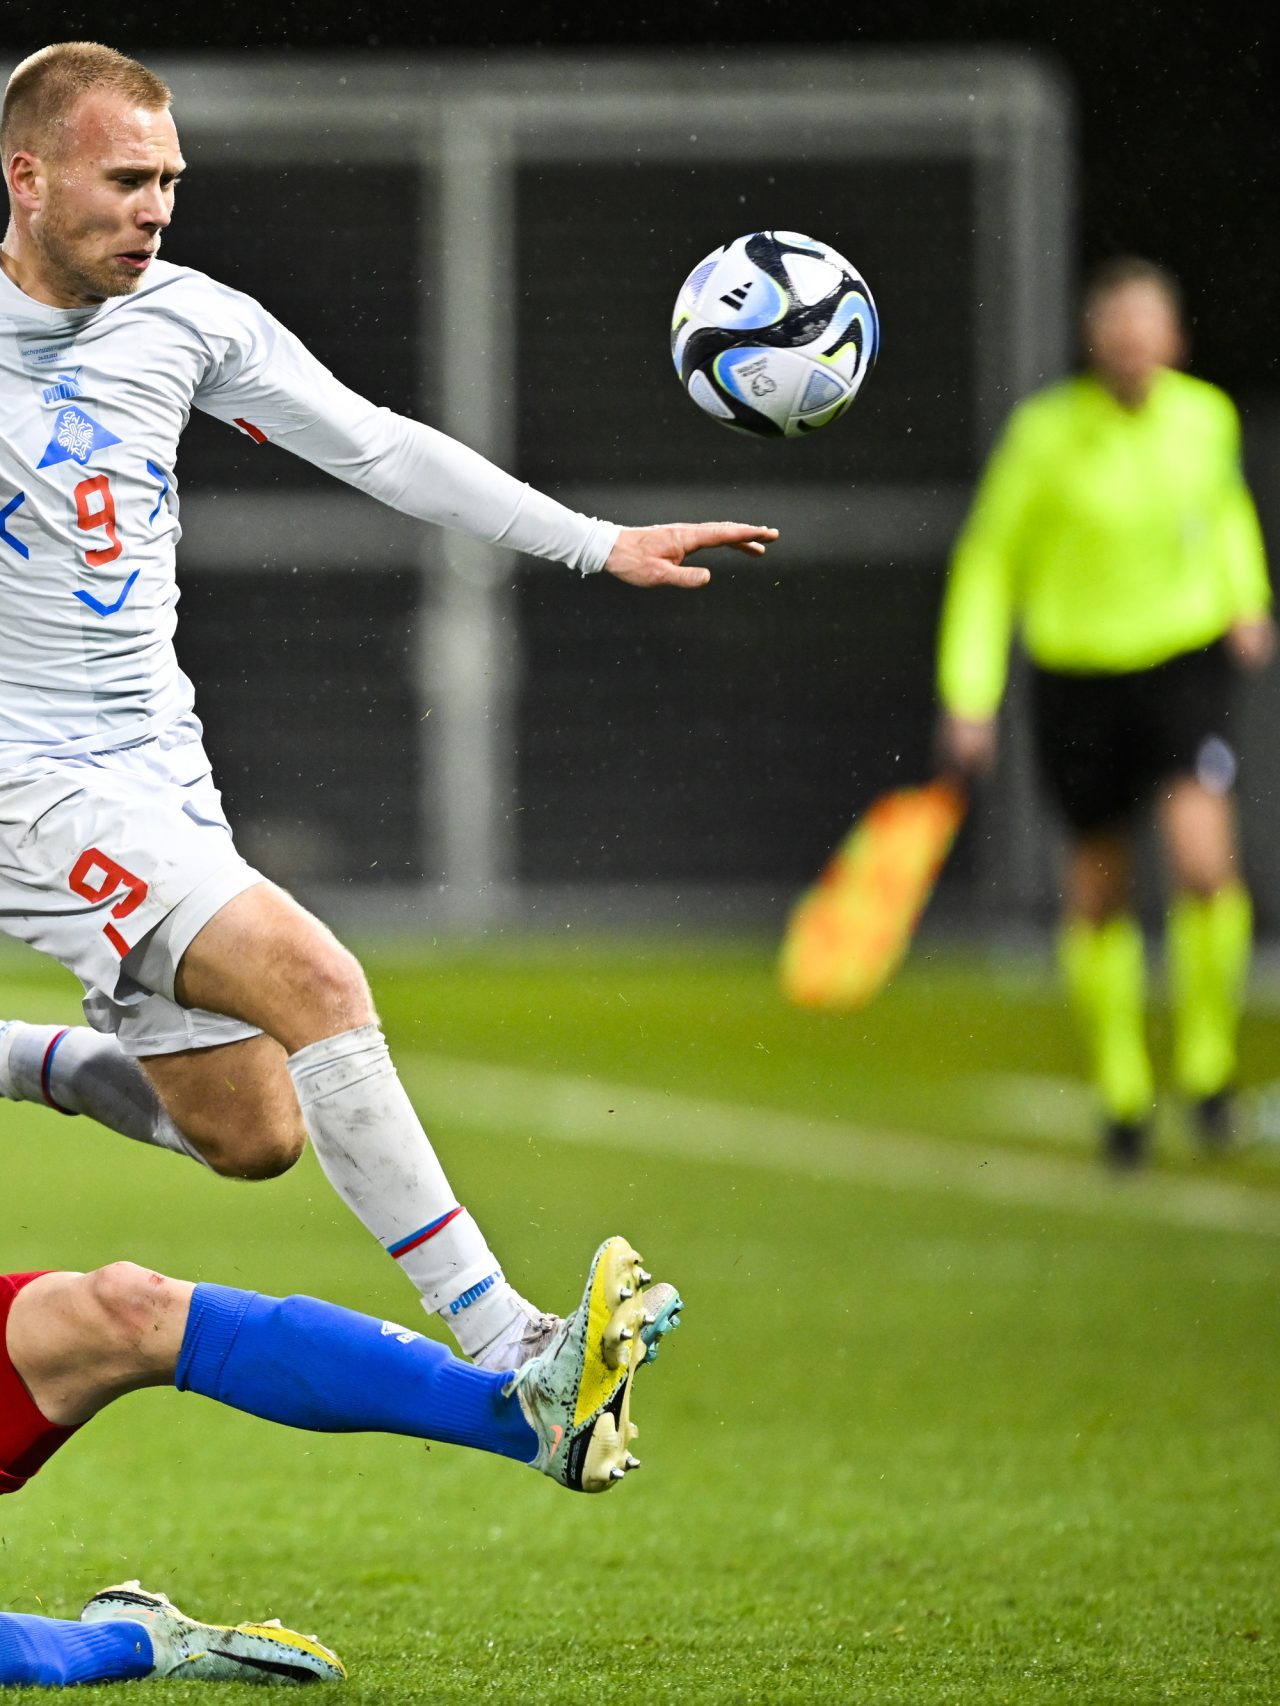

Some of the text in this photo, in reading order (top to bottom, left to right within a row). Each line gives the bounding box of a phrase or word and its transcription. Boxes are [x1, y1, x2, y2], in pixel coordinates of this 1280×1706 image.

[73, 473, 123, 567] 9
[68, 847, 148, 919] 9
[450, 1274, 495, 1315] PUMA
